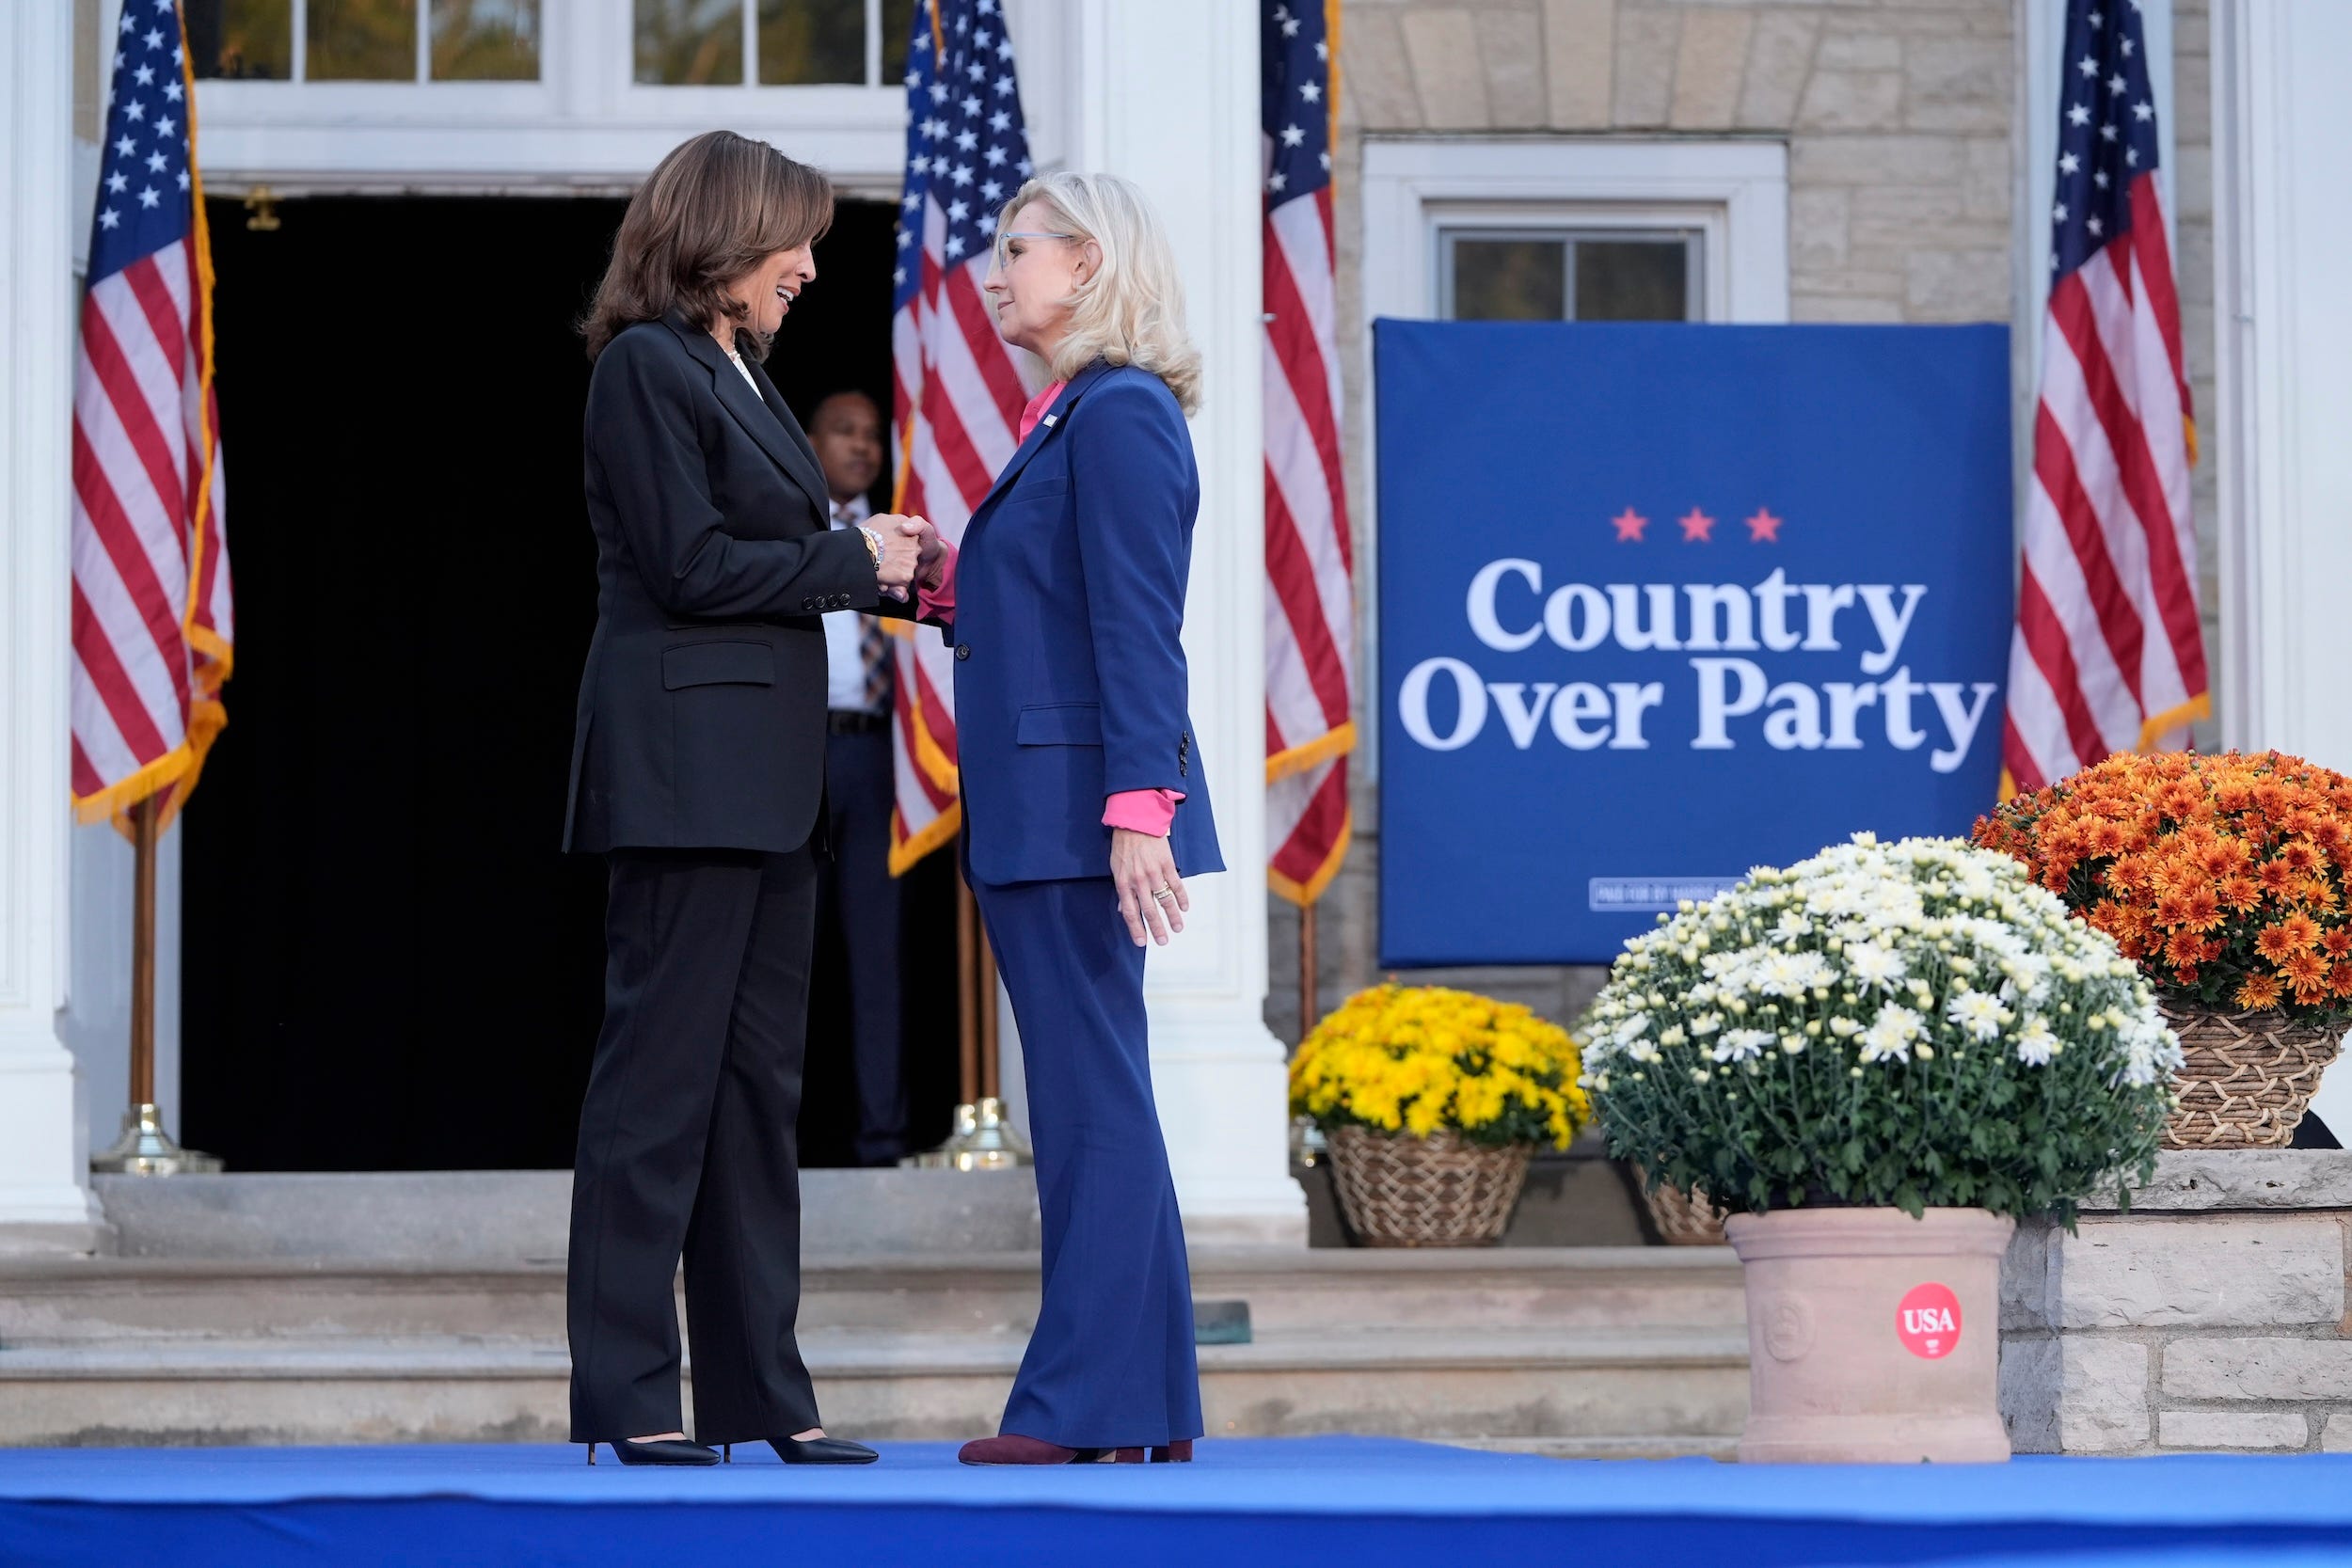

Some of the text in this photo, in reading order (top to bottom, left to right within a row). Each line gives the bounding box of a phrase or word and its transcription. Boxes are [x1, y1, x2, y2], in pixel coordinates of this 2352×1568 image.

[1467, 558, 1926, 674] Country
[1398, 657, 1994, 772] Over Party
[1903, 1307, 1956, 1334] USA
